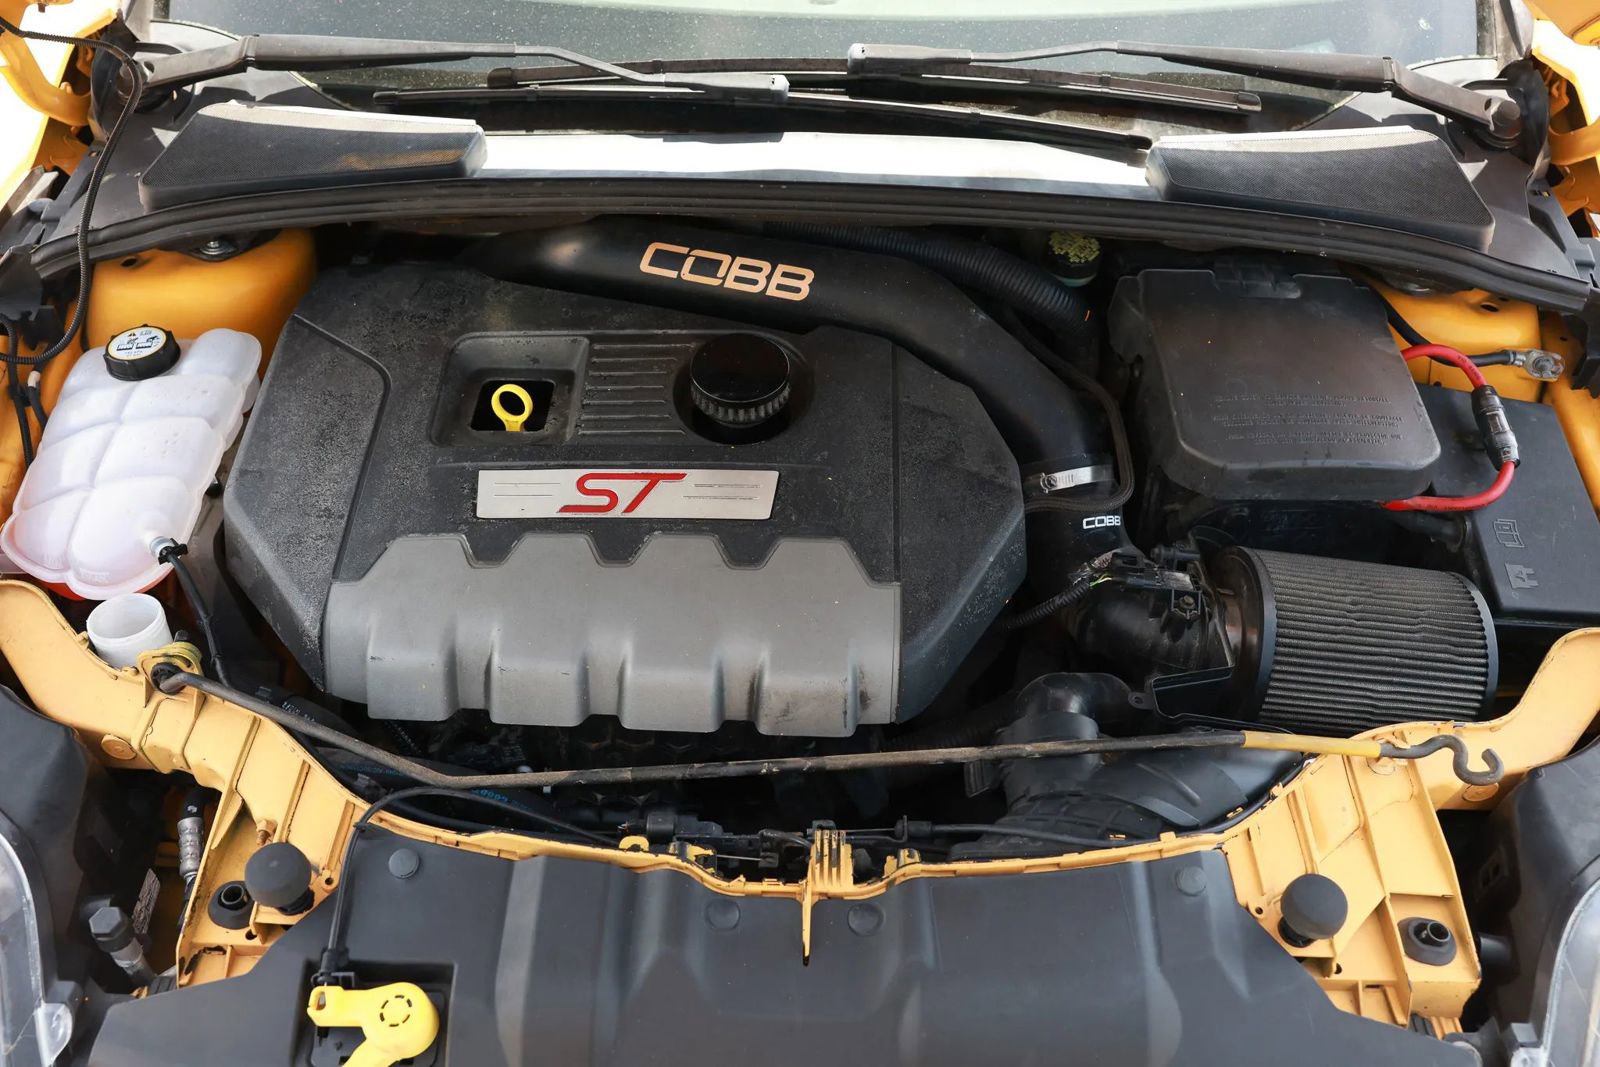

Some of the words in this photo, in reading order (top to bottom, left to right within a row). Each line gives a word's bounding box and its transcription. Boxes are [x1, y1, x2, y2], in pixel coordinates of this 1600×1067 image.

[640, 241, 815, 301] COBB
[557, 472, 687, 513] ST
[1082, 515, 1121, 530] COBB
